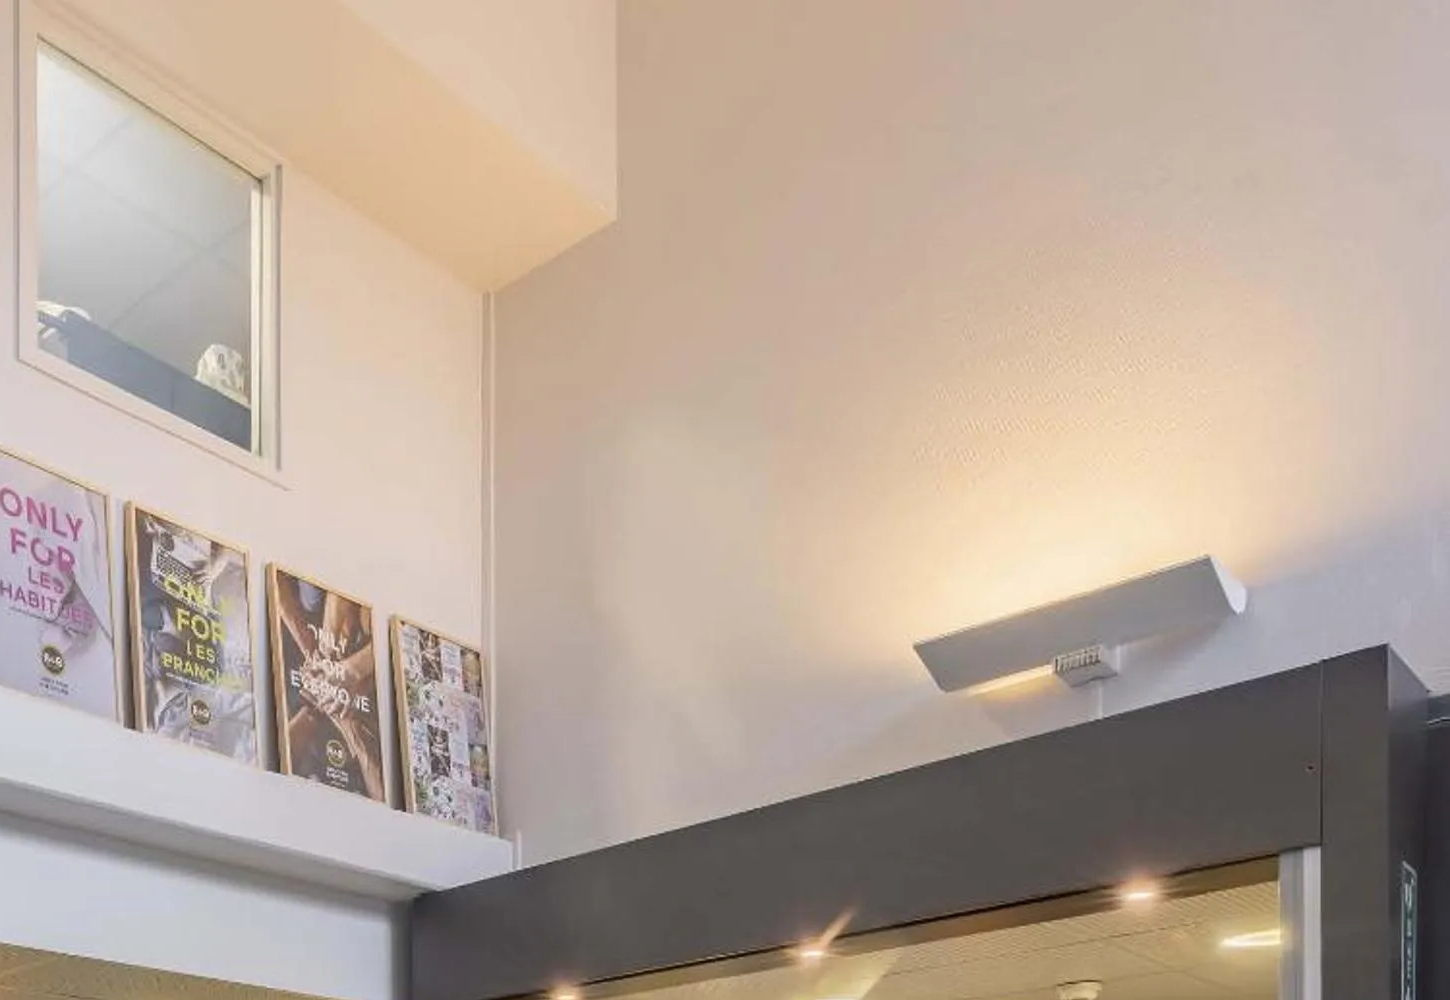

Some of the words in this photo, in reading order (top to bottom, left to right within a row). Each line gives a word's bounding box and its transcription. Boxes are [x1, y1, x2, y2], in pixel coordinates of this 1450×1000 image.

[10, 527, 76, 575] FOR
[28, 566, 65, 594] LES
[176, 606, 228, 645] FOR
